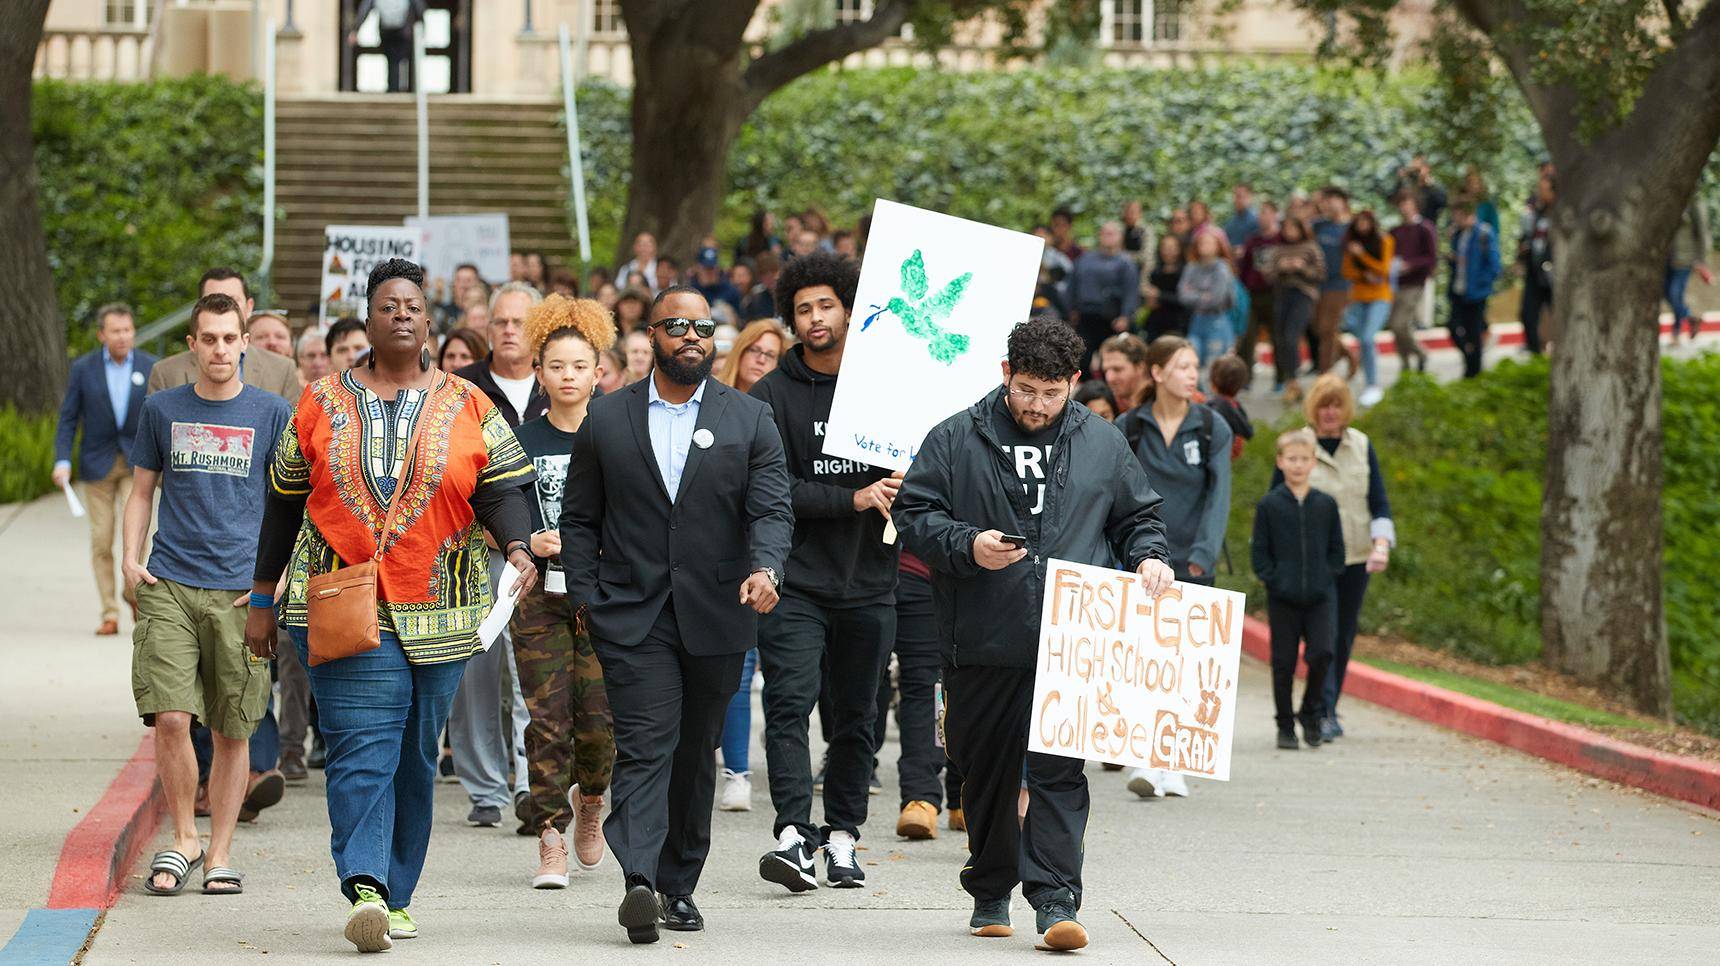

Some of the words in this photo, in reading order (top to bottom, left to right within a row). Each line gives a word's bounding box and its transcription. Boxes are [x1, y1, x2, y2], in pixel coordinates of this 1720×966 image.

[325, 235, 413, 257] HOUSING
[348, 282, 368, 298] AL
[855, 433, 881, 453] Vote
[888, 441, 906, 458] for
[814, 459, 870, 475] RIGHTS
[1046, 632, 1106, 684] HIGH
[1096, 681, 1121, 717] &
[1039, 690, 1148, 759] College
[1153, 712, 1217, 771] GRAD
